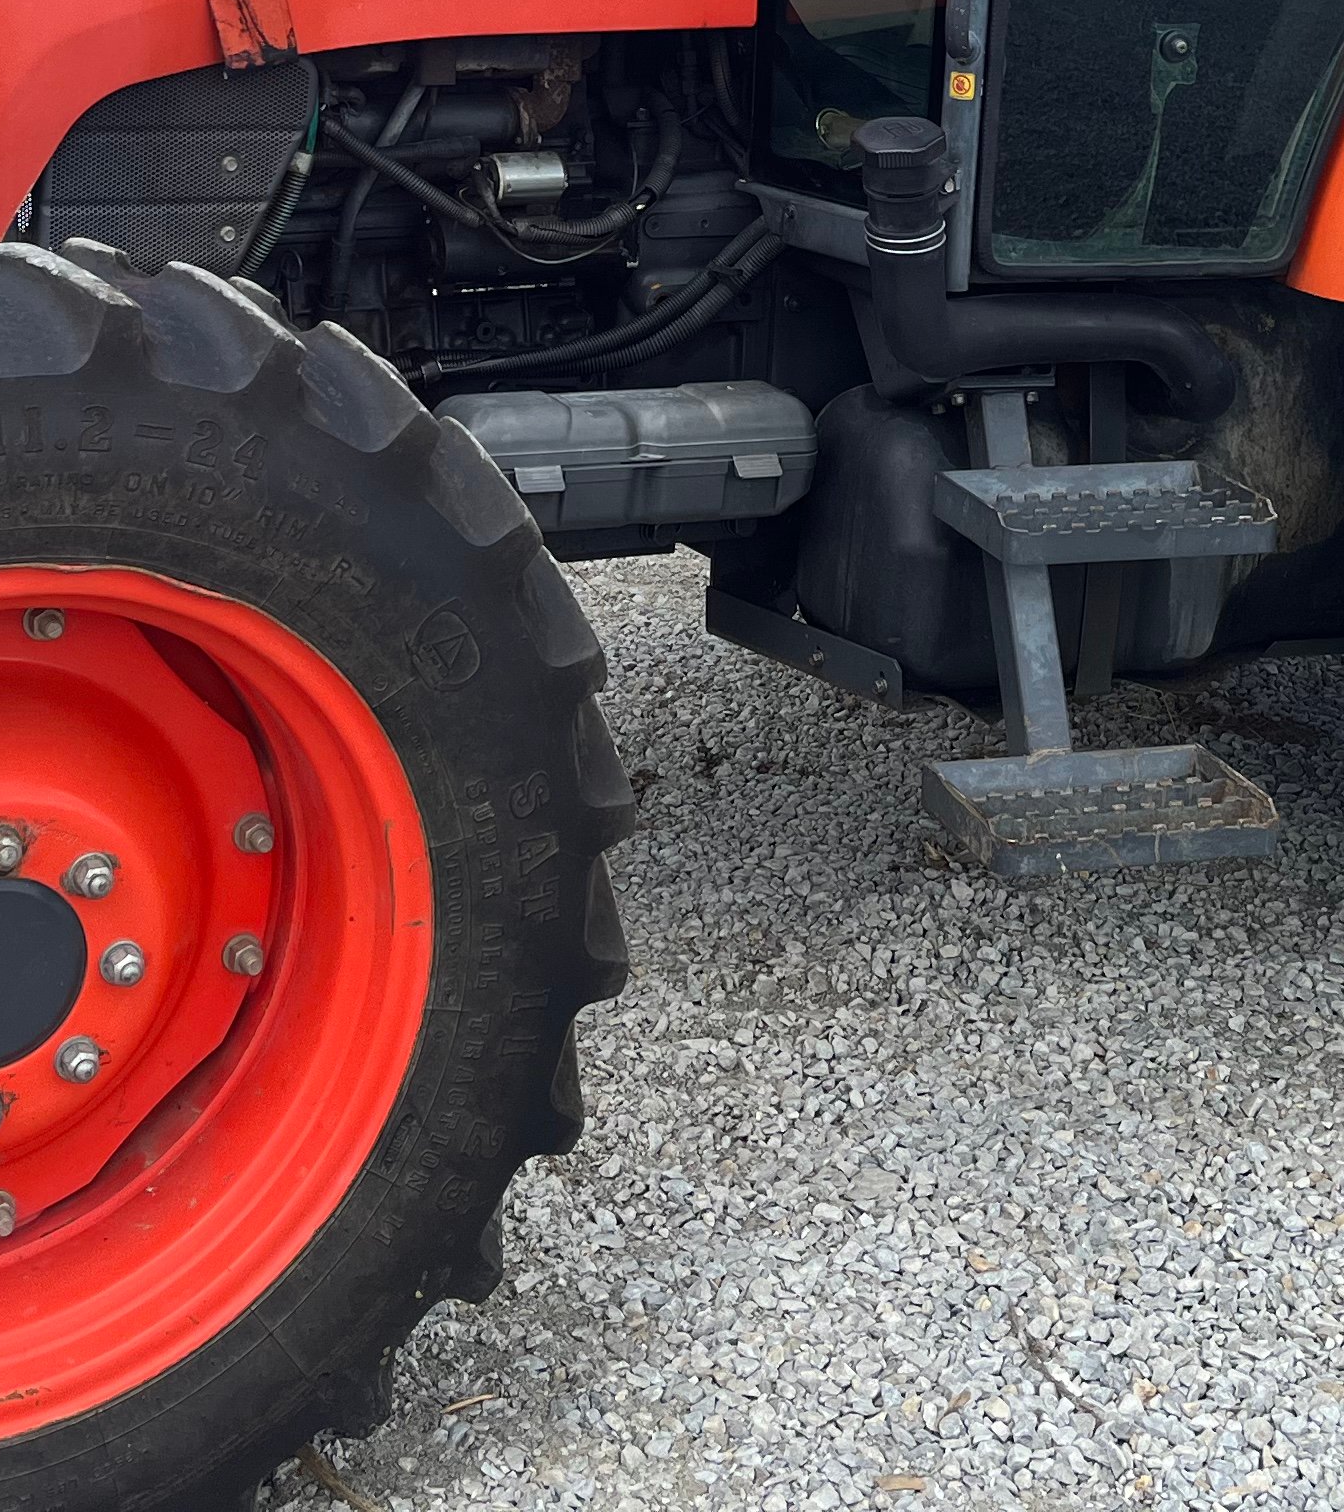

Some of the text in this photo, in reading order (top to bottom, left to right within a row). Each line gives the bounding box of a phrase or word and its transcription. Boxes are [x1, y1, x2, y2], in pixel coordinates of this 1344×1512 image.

[256, 505, 309, 542] RIM
[465, 775, 504, 900] SUPER
[475, 921, 505, 990] ALL
[405, 1012, 494, 1195] TRACTION
